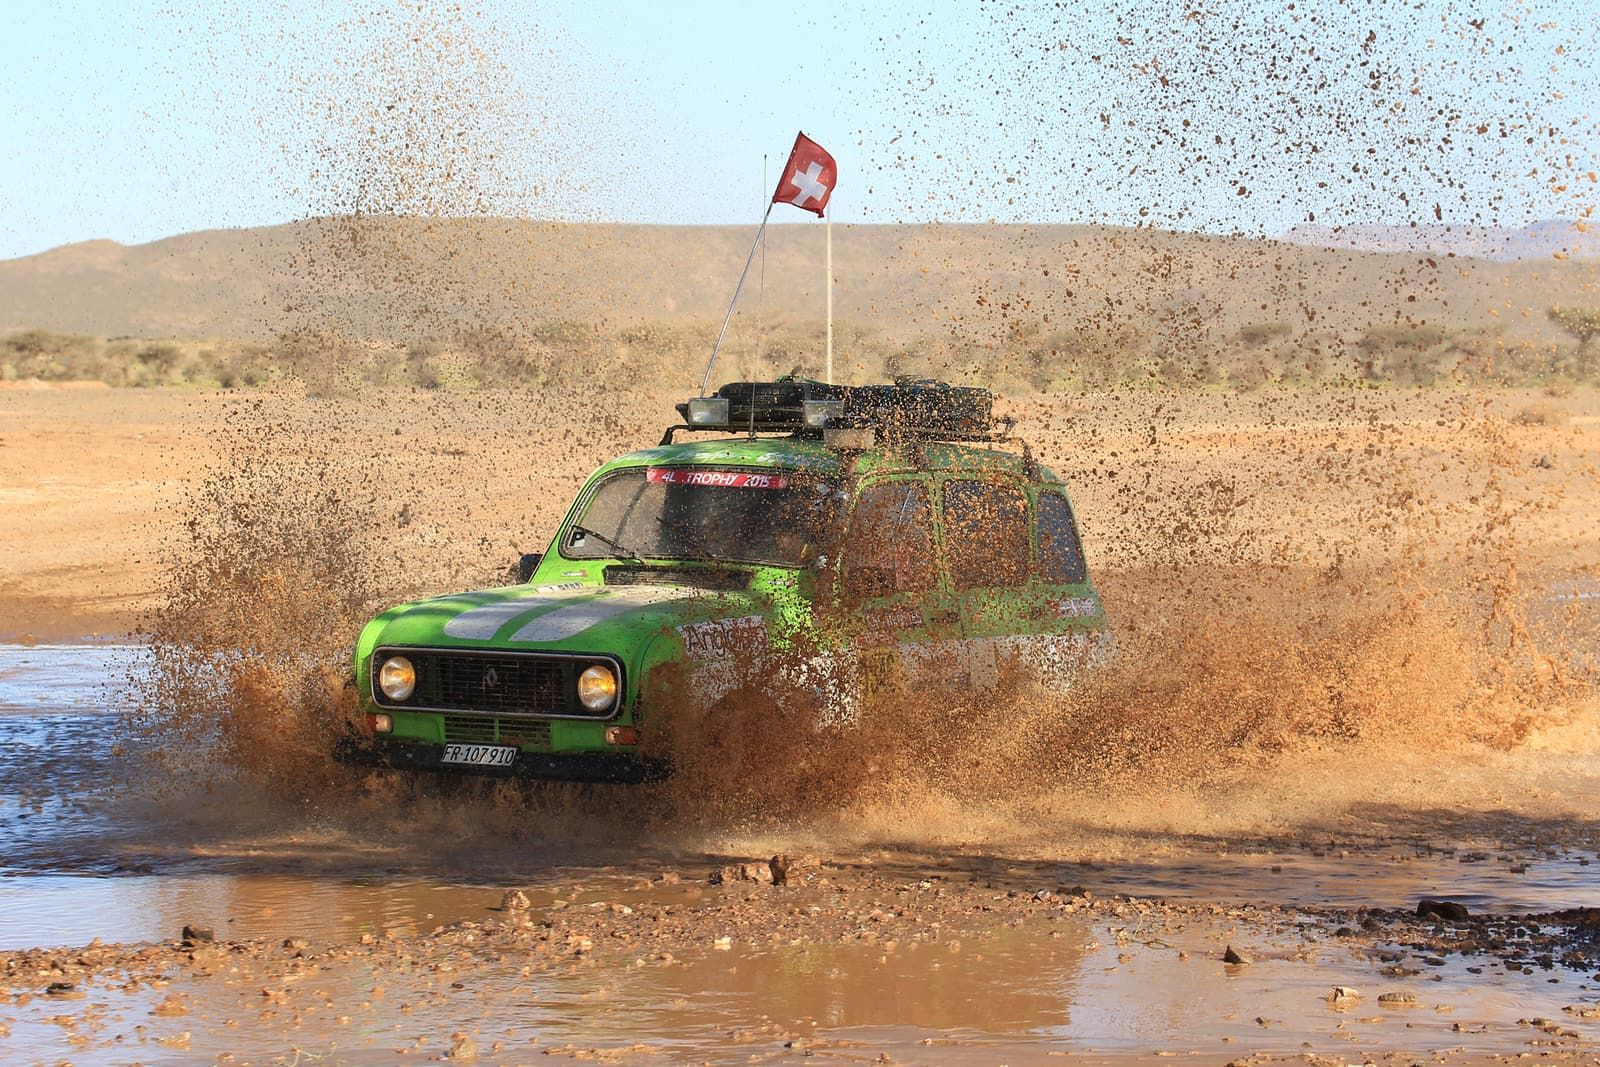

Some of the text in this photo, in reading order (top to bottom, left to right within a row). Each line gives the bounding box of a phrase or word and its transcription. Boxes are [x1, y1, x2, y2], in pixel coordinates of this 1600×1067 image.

[661, 471, 772, 488] 4L TROPHY 2015
